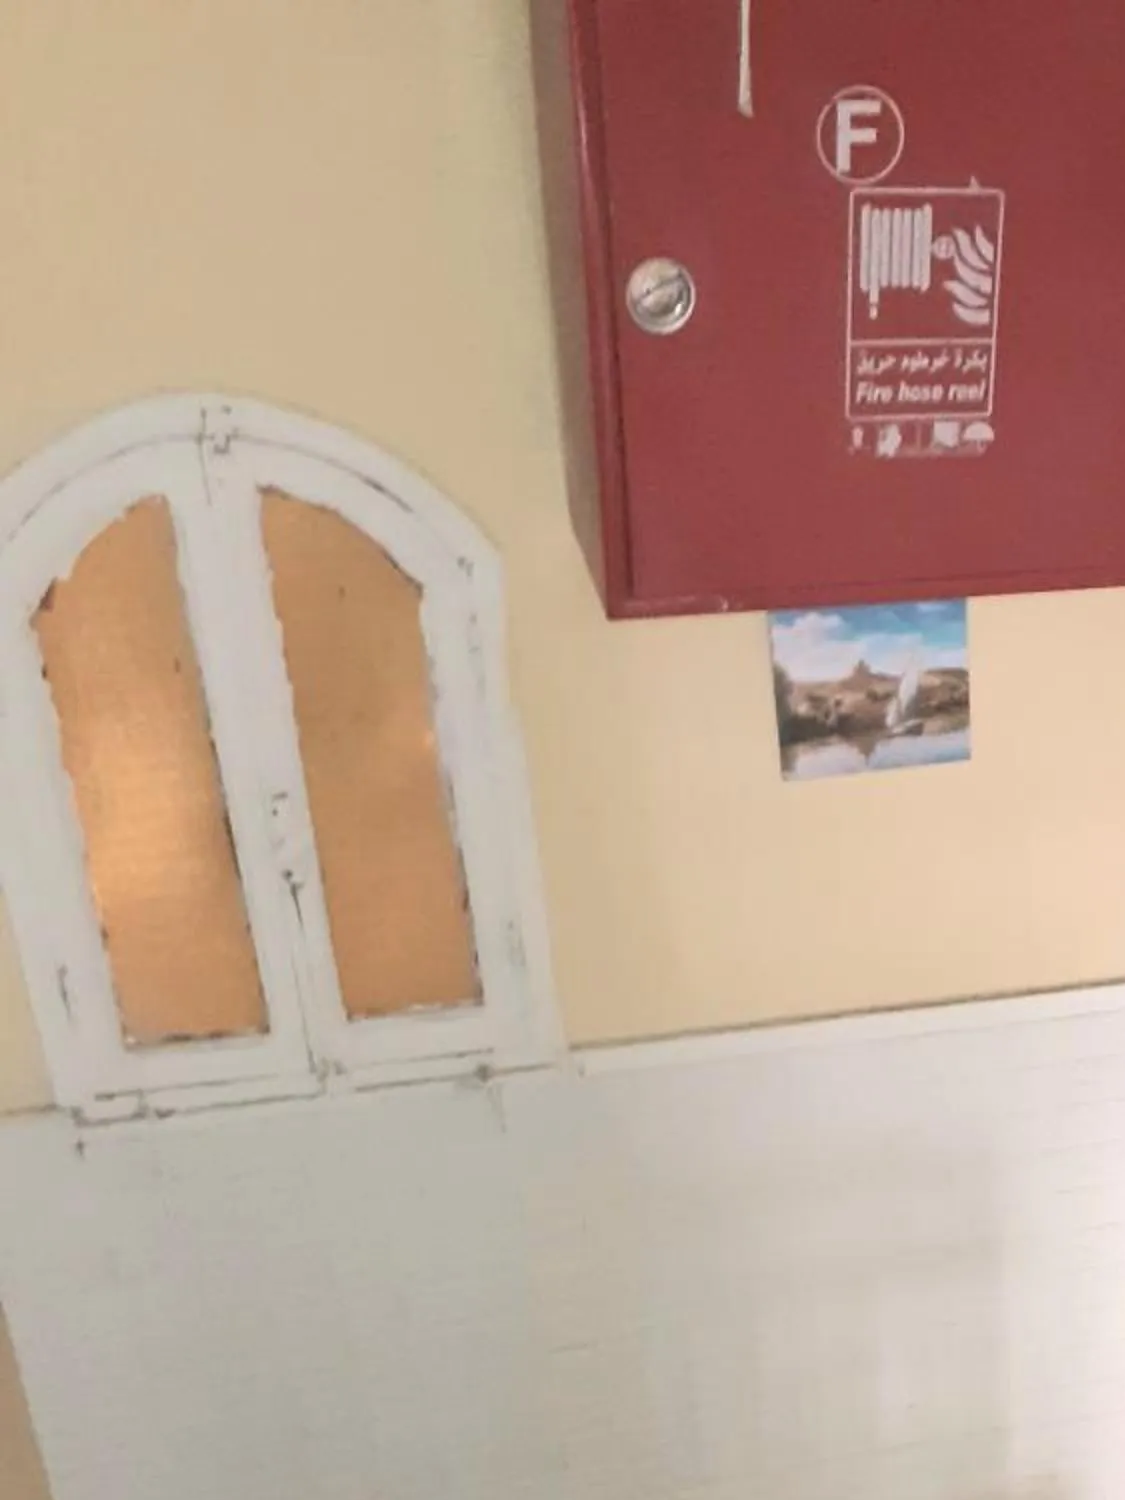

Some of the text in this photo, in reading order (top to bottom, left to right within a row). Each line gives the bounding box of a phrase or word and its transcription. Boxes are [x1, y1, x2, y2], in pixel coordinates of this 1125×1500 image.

[836, 100, 881, 173] F
[856, 379, 986, 403] Fire hose reel
